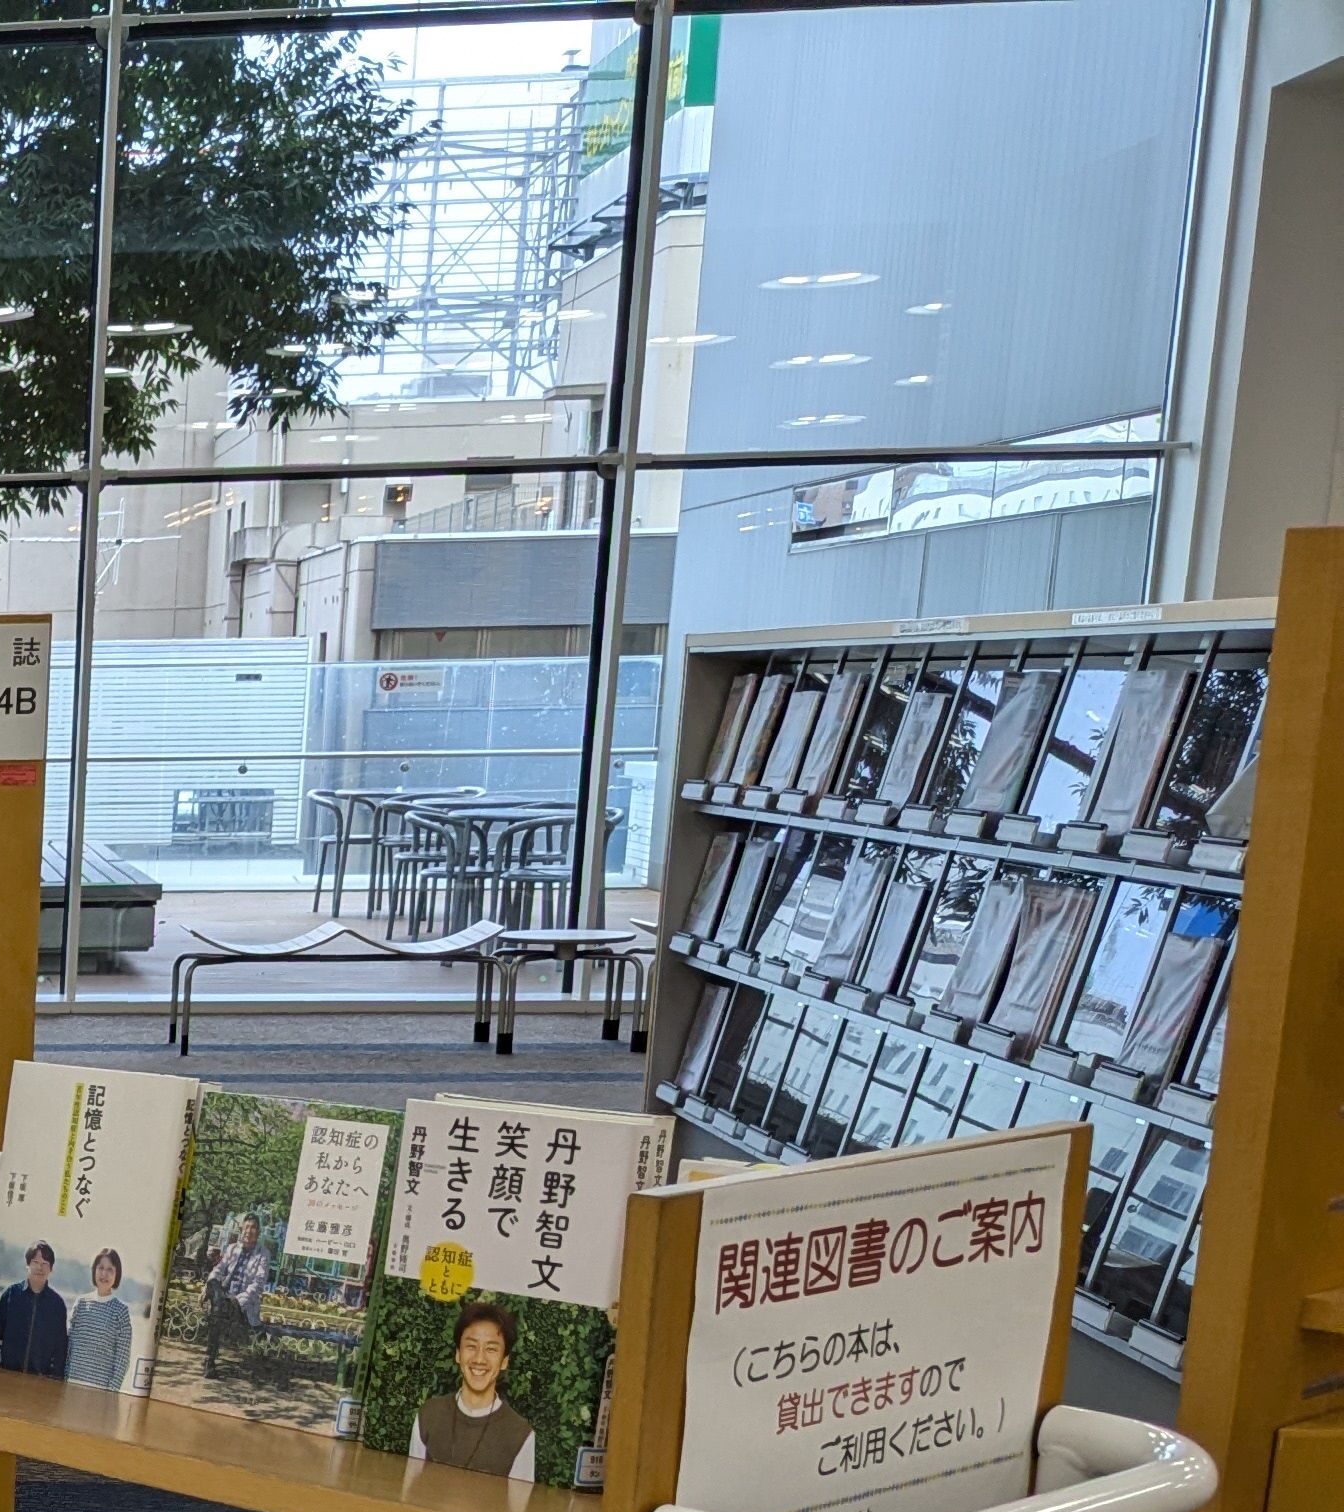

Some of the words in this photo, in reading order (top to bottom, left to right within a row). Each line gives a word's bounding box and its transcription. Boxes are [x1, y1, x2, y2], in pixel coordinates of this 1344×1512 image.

[75, 1085, 106, 1218] 記憶とつなぐ
[310, 1126, 379, 1151] 認知症の
[315, 1151, 363, 1175] 私から
[404, 1126, 428, 1196] 丹野智文
[440, 1116, 480, 1230] 生きる
[304, 1174, 369, 1198] あなたへ
[487, 1121, 531, 1238] 笑顔で
[527, 1128, 581, 1293] 丹野智文
[424, 1247, 473, 1267] 認知症
[715, 1190, 1046, 1315] 関連図書のご案内
[776, 1357, 966, 1436] 貸出できますので
